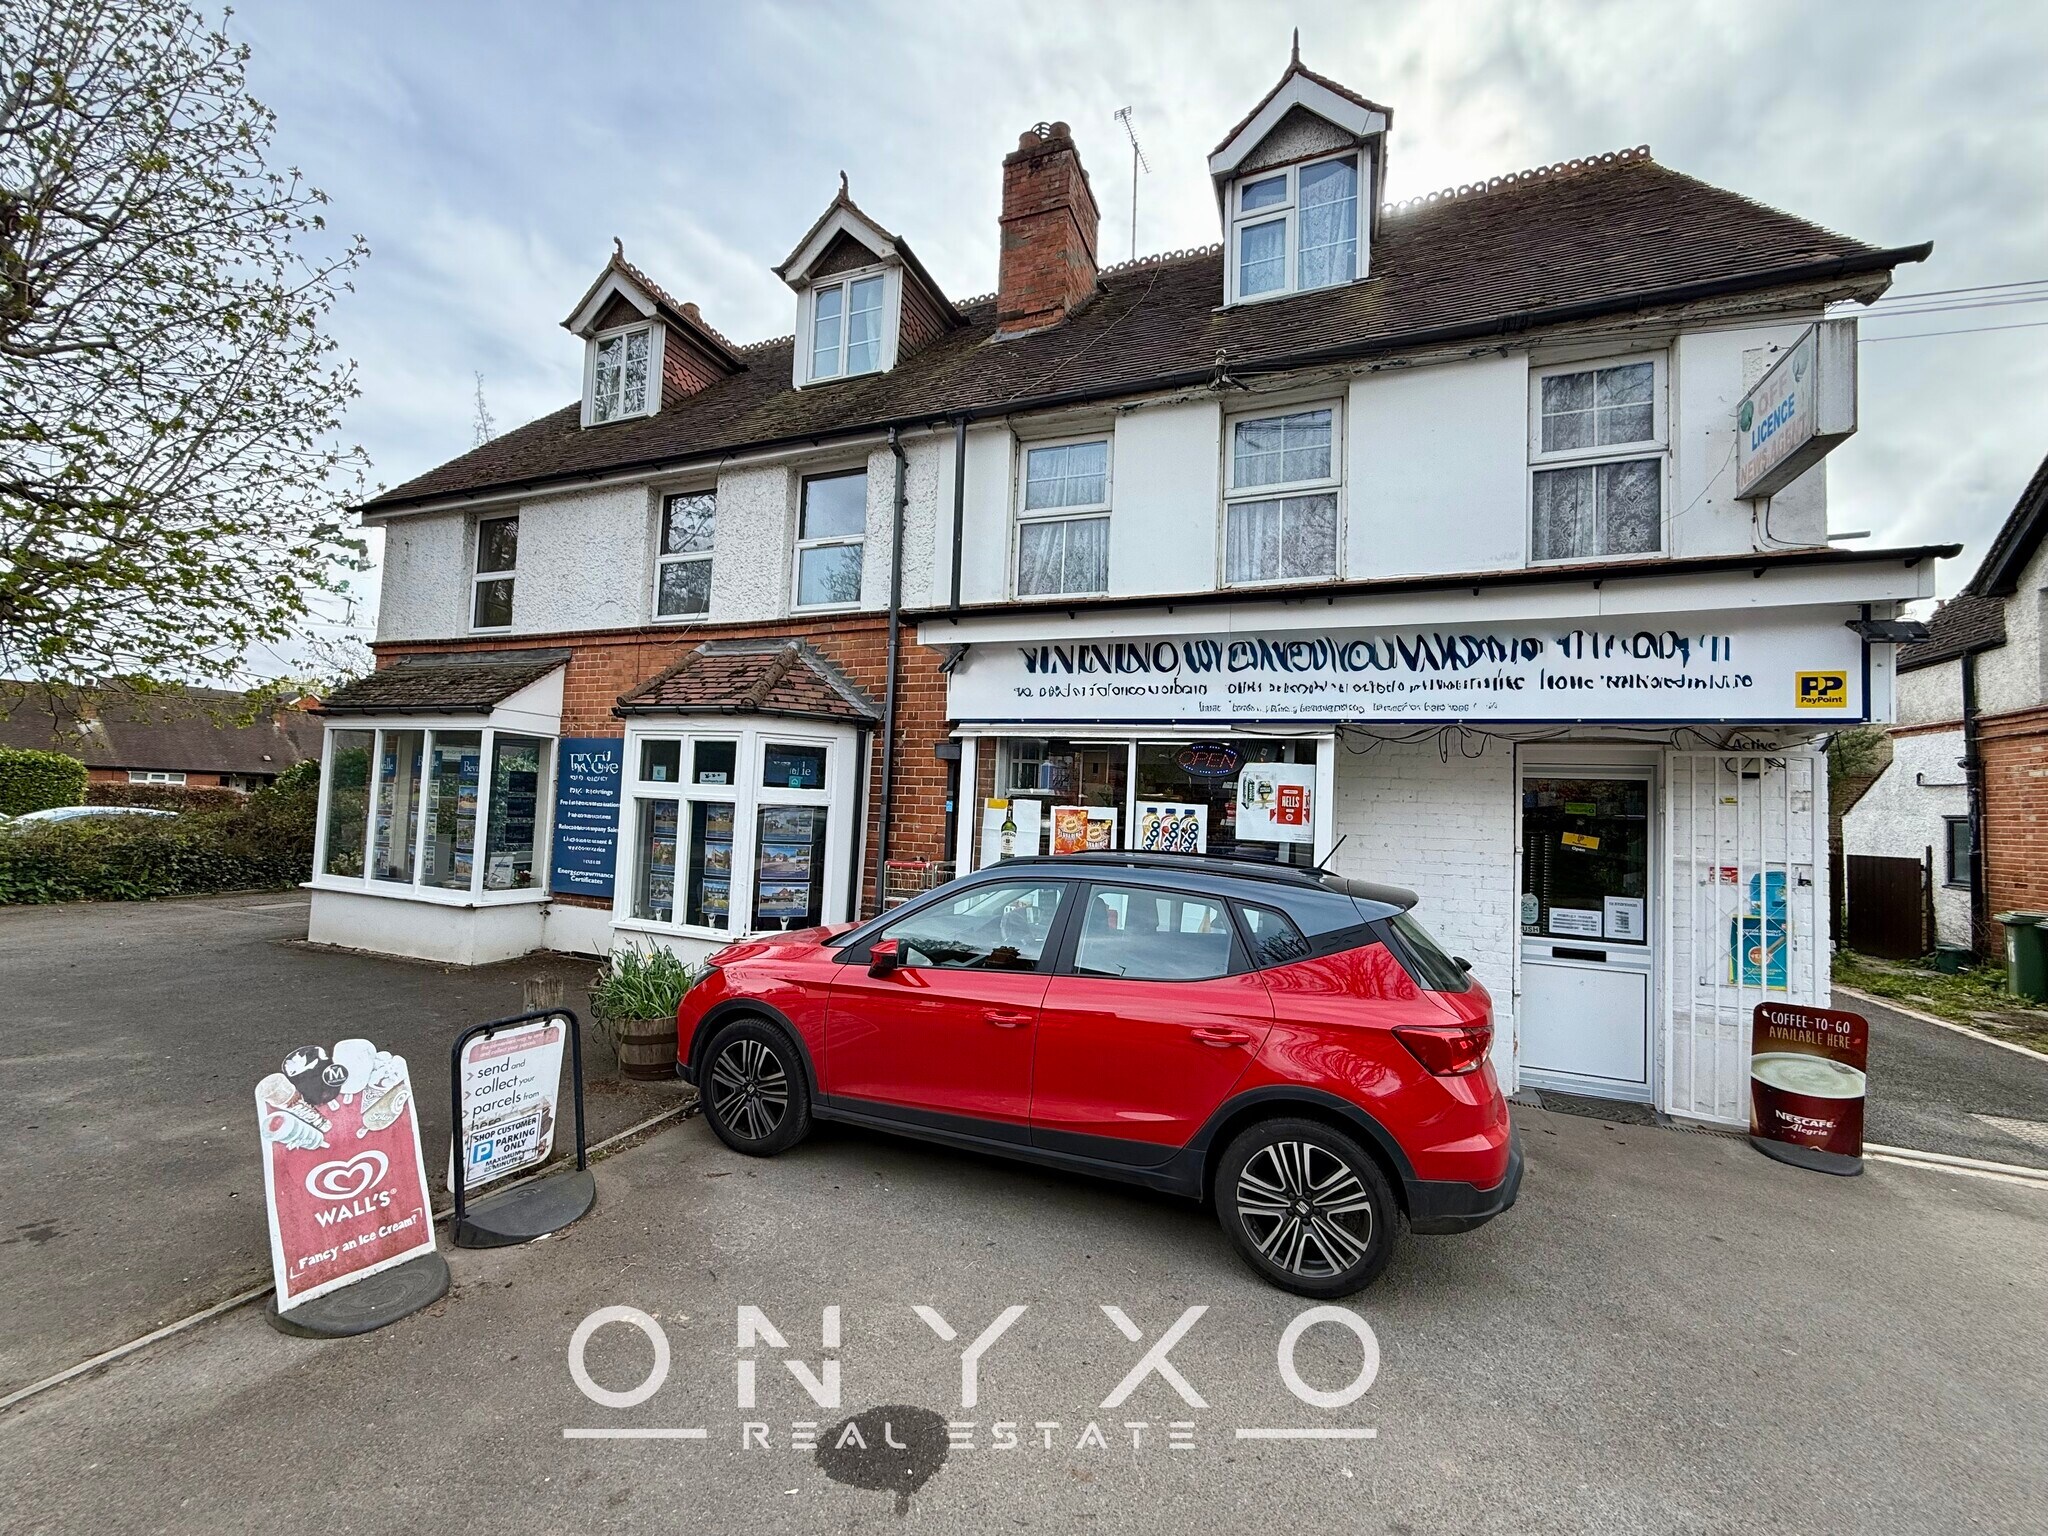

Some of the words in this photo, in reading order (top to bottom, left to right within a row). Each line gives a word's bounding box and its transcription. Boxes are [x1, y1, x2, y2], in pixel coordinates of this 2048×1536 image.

[1757, 368, 1789, 417] OFF
[1751, 392, 1795, 452] LICENCE
[1801, 696, 1843, 705] PayPoint
[1733, 738, 1777, 751] Active
[463, 760, 480, 772] Bevi
[1179, 751, 1238, 769] OPEN
[1770, 1011, 1850, 1034] COFFEE-TO-GO
[1769, 1025, 1822, 1046] AVAILABLE
[1827, 1033, 1851, 1049] HERE
[477, 1057, 510, 1079] send
[510, 1058, 526, 1071] and
[475, 1075, 518, 1097] collect
[518, 1075, 536, 1087] your
[472, 1089, 521, 1119] parcels
[523, 1091, 540, 1101] from
[473, 1130, 496, 1143] SHOP
[496, 1117, 537, 1136] CUSTOMER
[495, 1127, 536, 1148] PARKING
[1781, 1123, 1828, 1137] Alegria
[503, 1138, 527, 1153] ONLY
[485, 1149, 521, 1167] MAXIMUM
[314, 1190, 391, 1228] WALL'S
[298, 1245, 340, 1270] Fancy
[341, 1239, 357, 1252] an
[359, 1231, 377, 1246] Ice
[378, 1214, 418, 1238] Cream?
